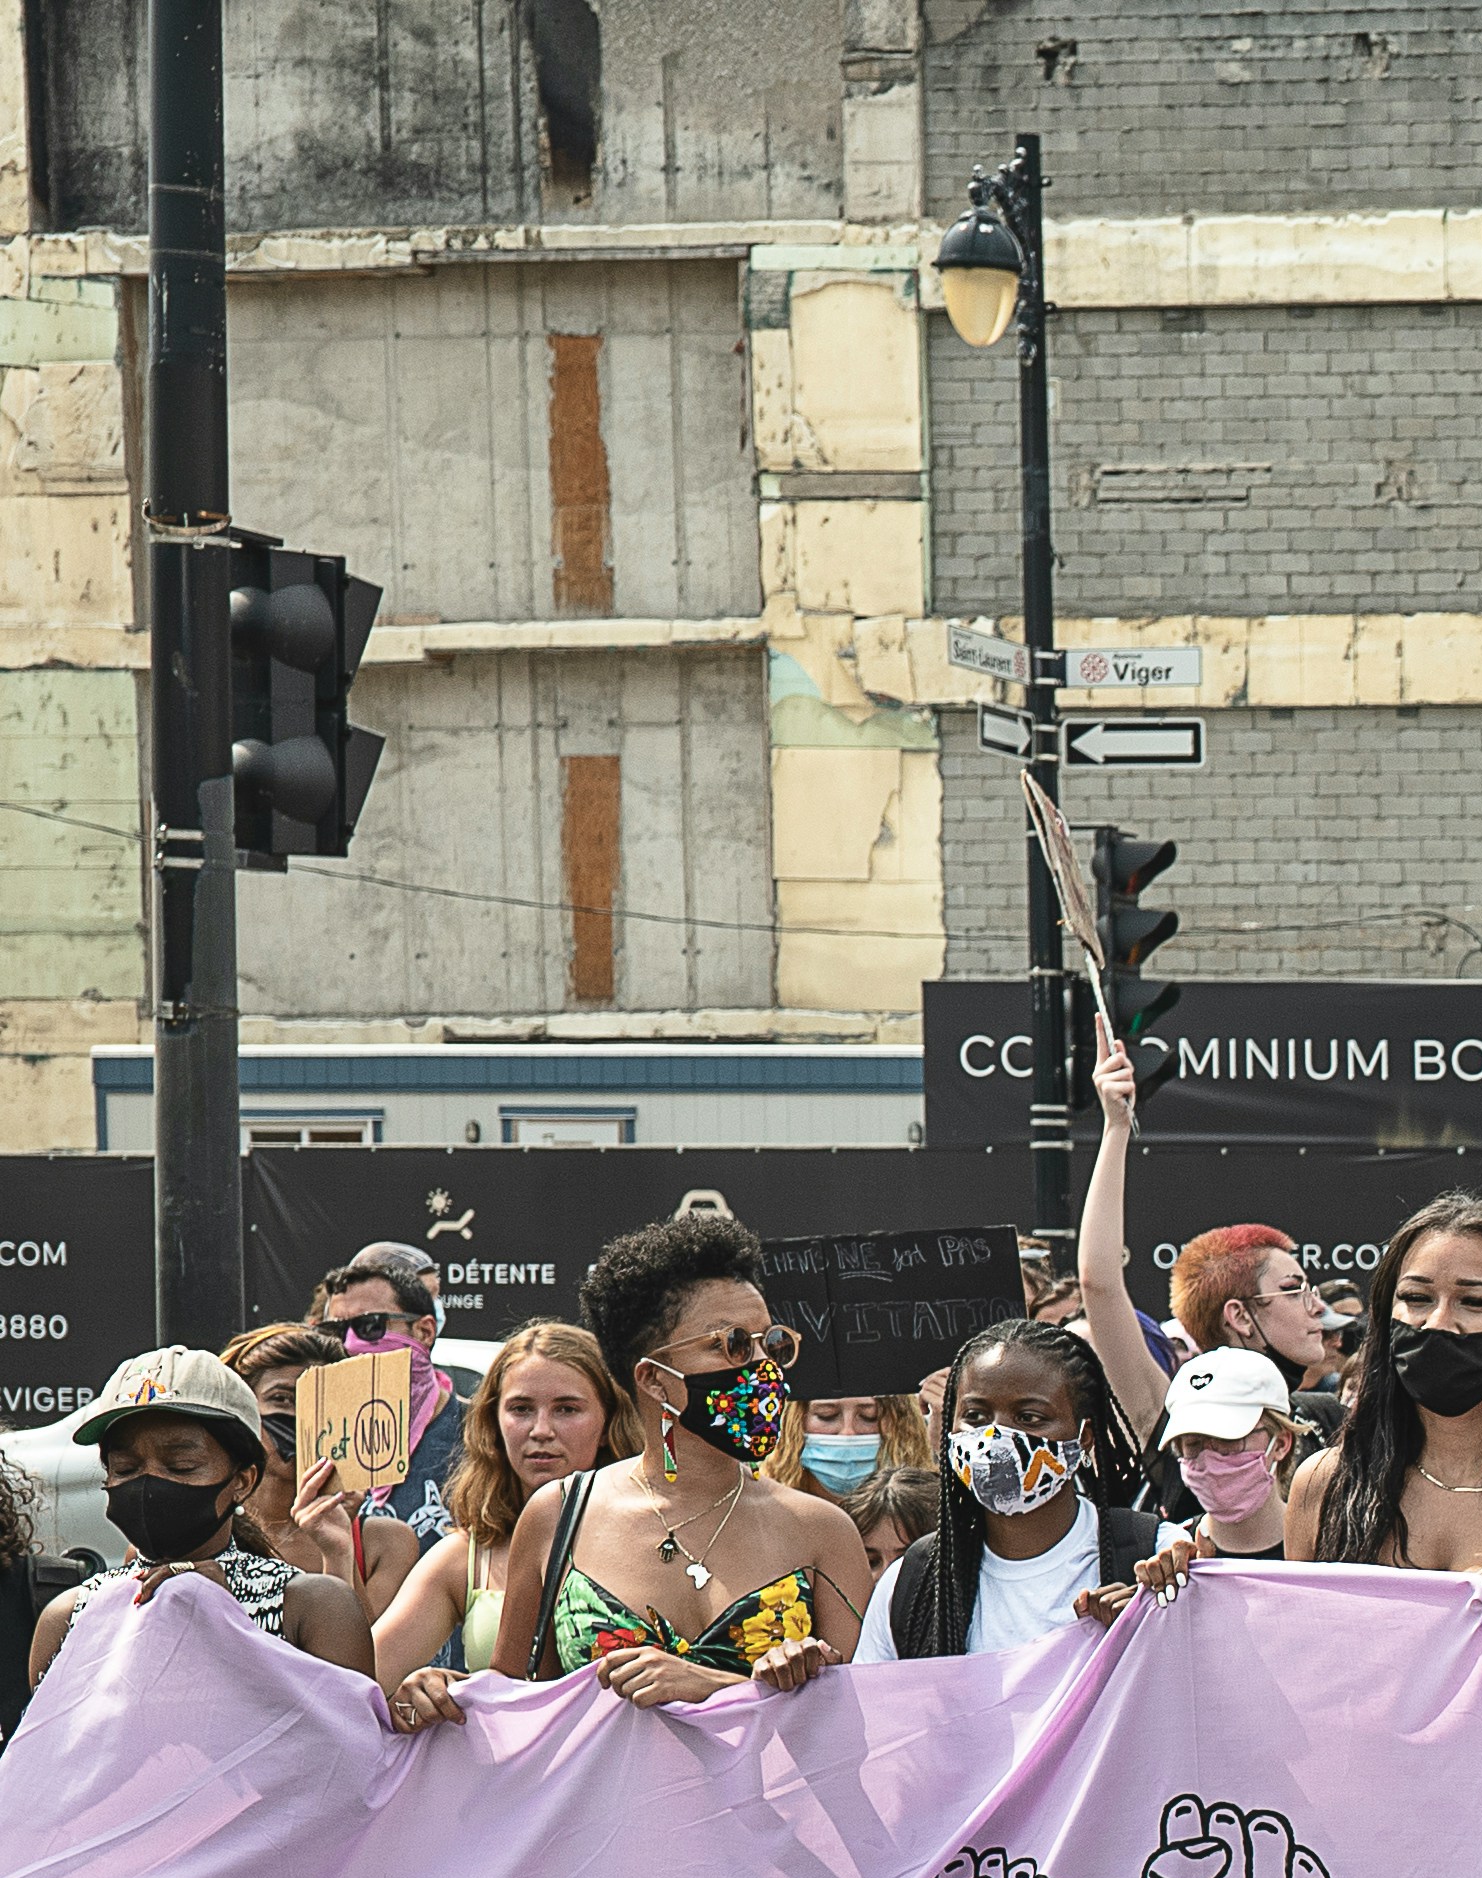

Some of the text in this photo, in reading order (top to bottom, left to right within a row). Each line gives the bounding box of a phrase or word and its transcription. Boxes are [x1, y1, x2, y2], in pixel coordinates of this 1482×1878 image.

[1113, 662, 1174, 687] Viger
[959, 1034, 1389, 1083] COMINIUM
[834, 1241, 881, 1271] NE
[937, 1236, 992, 1267] PAS
[448, 1258, 556, 1284] DÉTENTE
[0, 1386, 94, 1412] VIGER
[316, 1417, 350, 1460] C'est
[362, 1417, 390, 1455] NON
